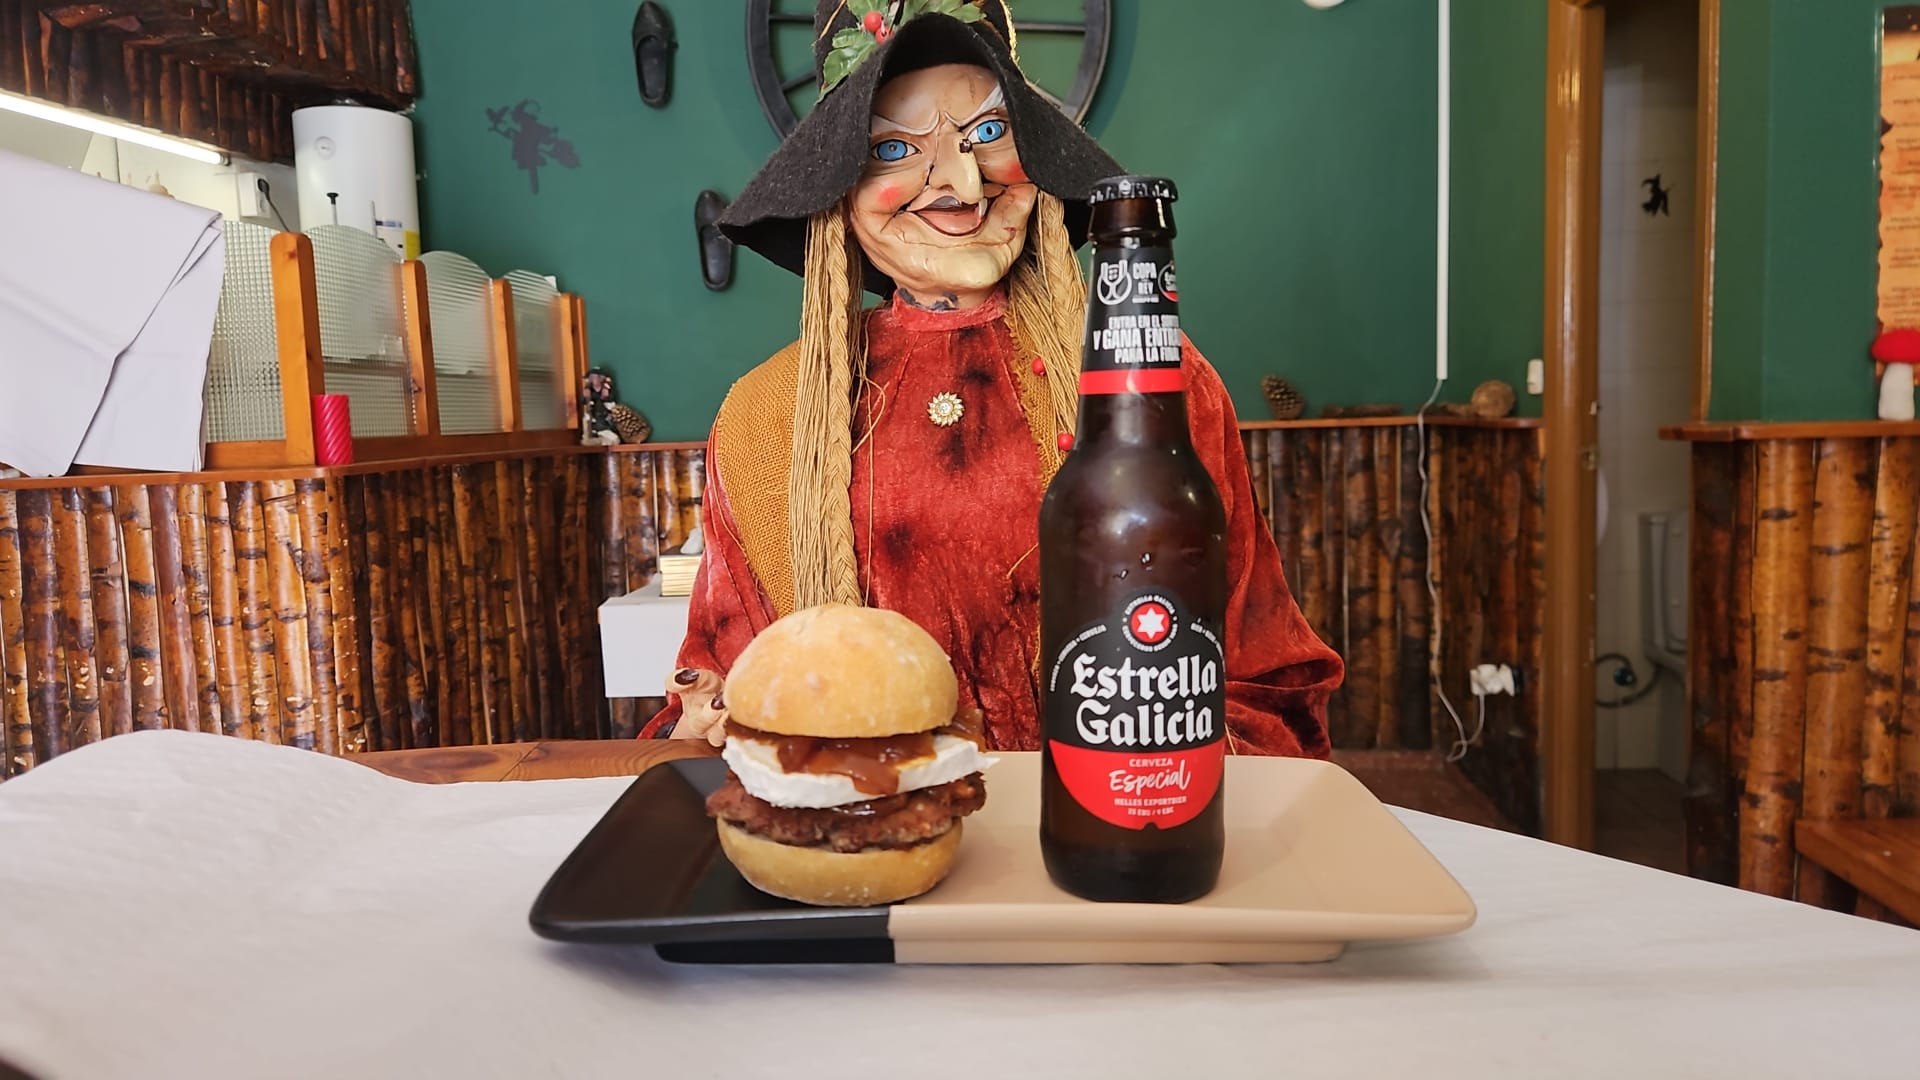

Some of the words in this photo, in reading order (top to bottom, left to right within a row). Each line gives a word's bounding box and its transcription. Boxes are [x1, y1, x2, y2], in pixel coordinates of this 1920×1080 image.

[1133, 262, 1157, 279] COPA
[1093, 330, 1101, 350] Y
[1102, 328, 1142, 349] GANA
[1114, 347, 1144, 364] PARA
[1145, 347, 1159, 362] LA
[1070, 652, 1217, 700] Estrella
[1076, 699, 1213, 746] Galicia
[1129, 758, 1174, 767] CERVEZA
[1109, 759, 1191, 796] Especial
